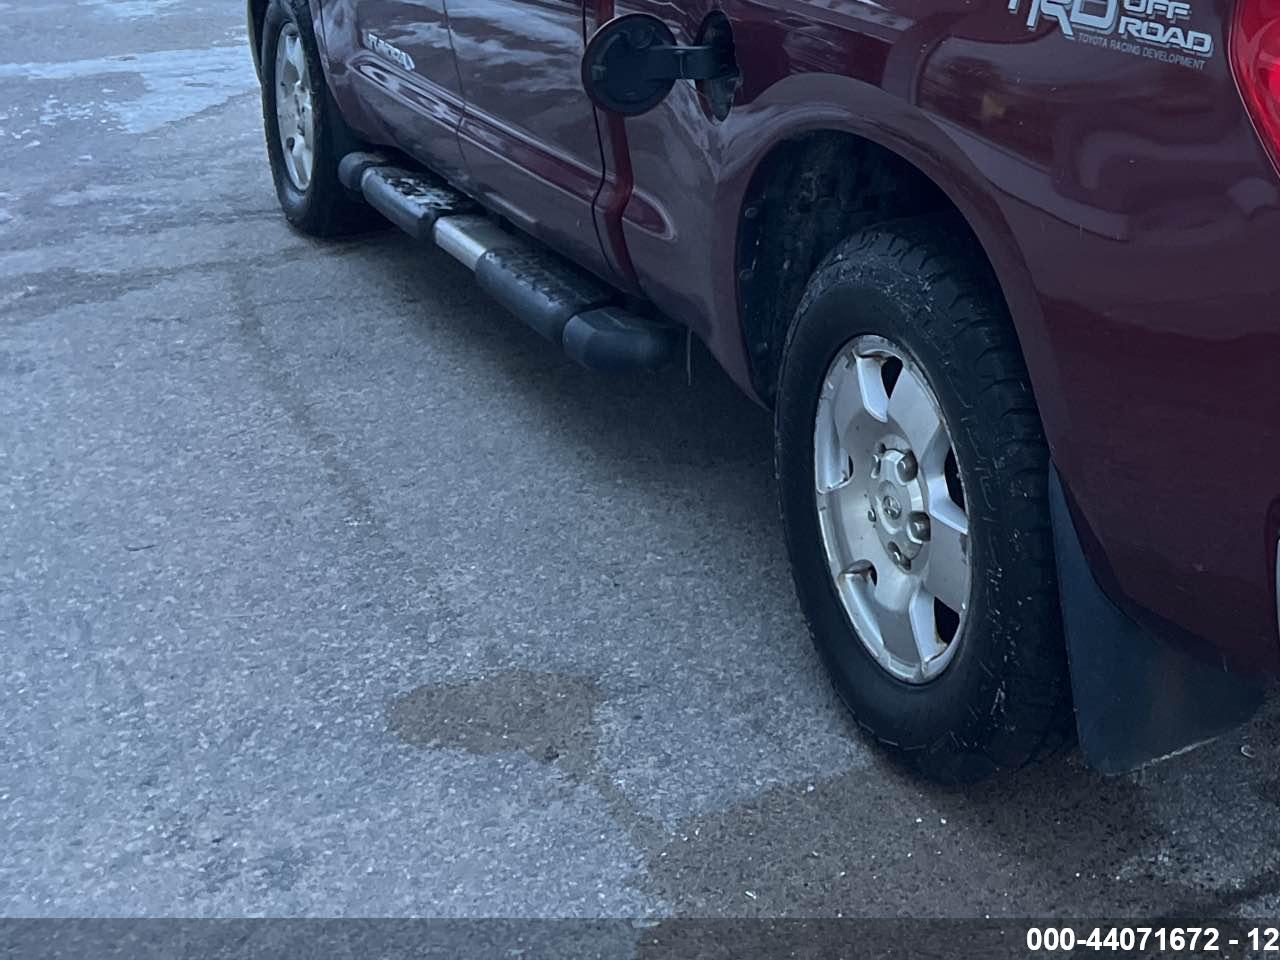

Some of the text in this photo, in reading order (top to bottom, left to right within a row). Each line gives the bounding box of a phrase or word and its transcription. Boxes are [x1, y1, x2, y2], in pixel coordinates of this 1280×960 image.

[1078, 32, 1206, 70] TOYOTA RACING DEVELOPMENT
[1118, 15, 1213, 54] ROAD
